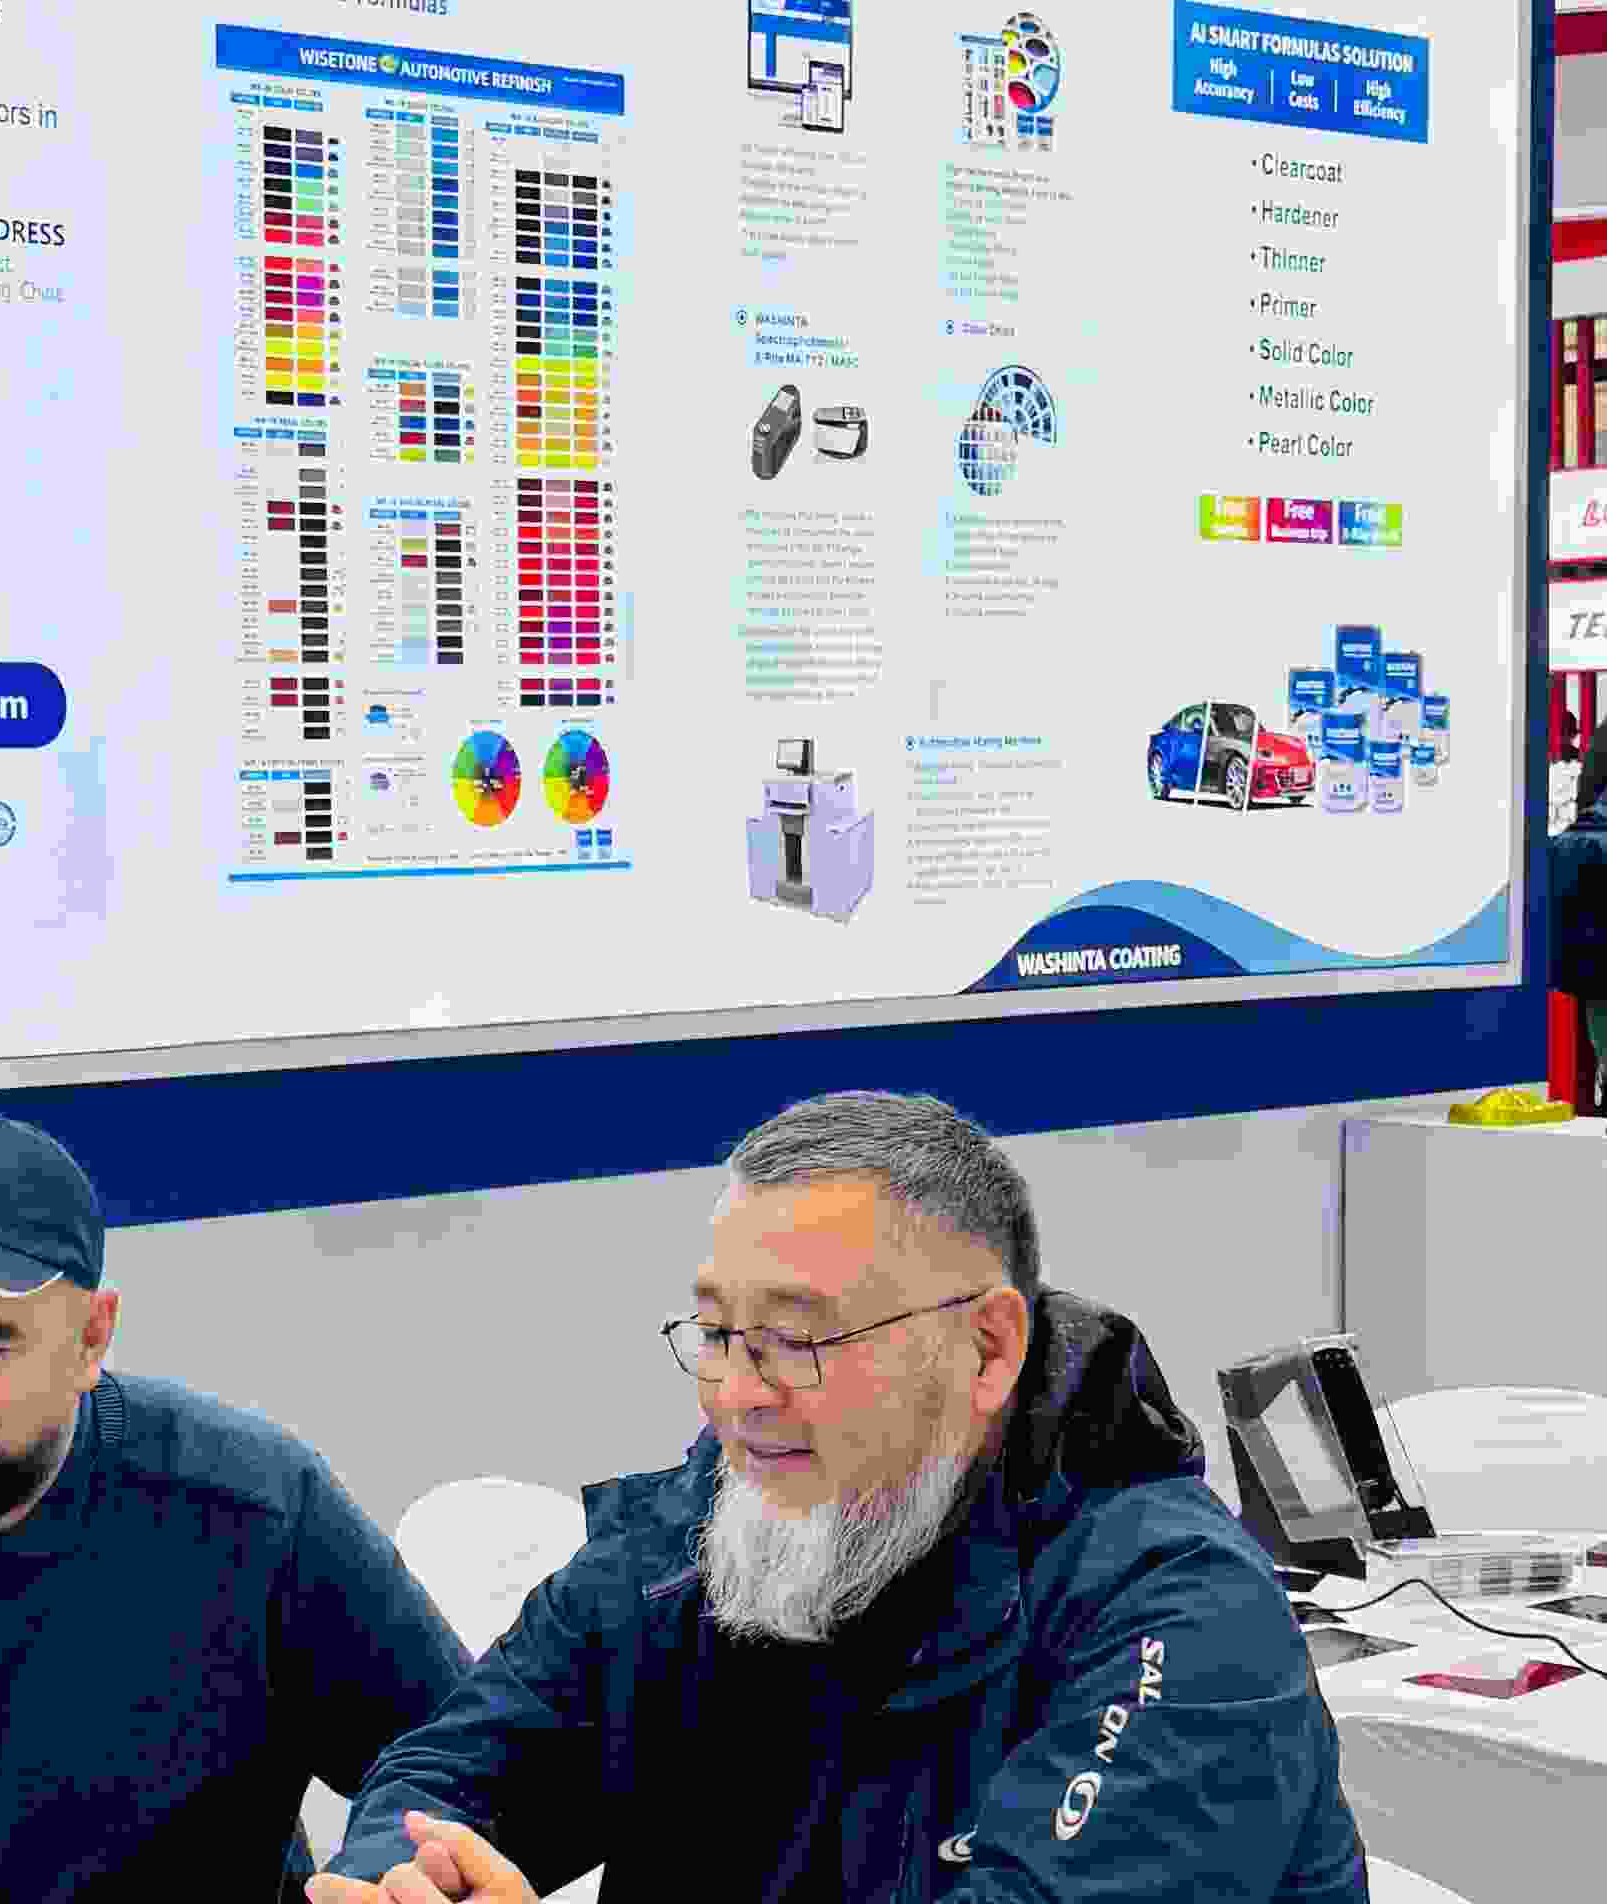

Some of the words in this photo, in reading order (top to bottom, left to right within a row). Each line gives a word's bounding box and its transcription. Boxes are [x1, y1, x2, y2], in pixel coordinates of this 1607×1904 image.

[1210, 25, 1259, 51] SMART
[1262, 33, 1340, 65] FORMULAS
[1343, 45, 1414, 73] SOLUTION
[298, 47, 378, 73] WISETONE
[399, 61, 491, 89] AUTOMOTIVE
[38, 106, 59, 129] in
[1261, 152, 1344, 184] Clearcoat
[1261, 199, 1340, 229] Hardener
[1261, 245, 1326, 273] Thinner
[1260, 292, 1318, 319] Primer
[1259, 337, 1303, 364] Solid
[1308, 343, 1354, 369] Color
[1259, 385, 1325, 412] Metallic
[1329, 389, 1374, 415] Color
[1259, 432, 1303, 456] Pearl
[1308, 433, 1353, 458] Color
[1018, 948, 1107, 977] WASHINTA
[1110, 943, 1182, 970] COATING
